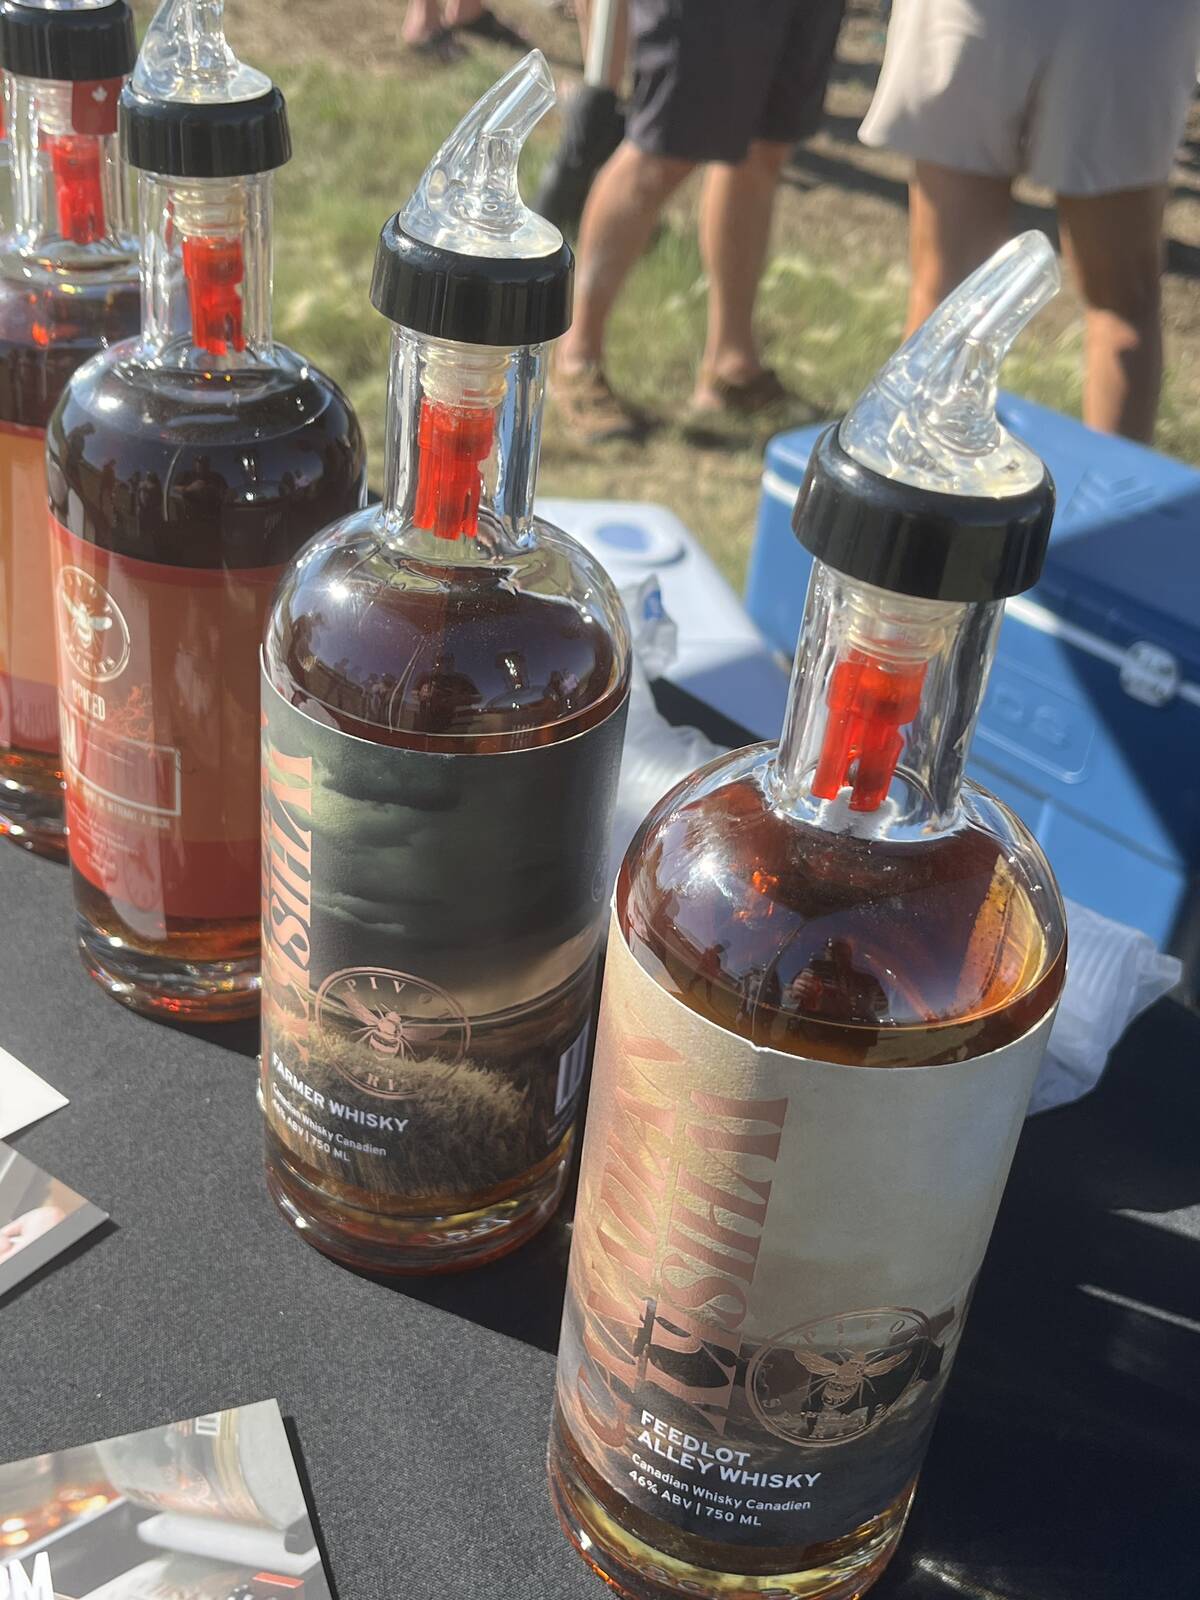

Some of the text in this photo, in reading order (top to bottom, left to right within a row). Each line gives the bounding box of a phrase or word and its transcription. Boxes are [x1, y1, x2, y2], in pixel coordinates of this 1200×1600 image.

[273, 1052, 325, 1109] FARMER
[329, 1099, 409, 1132] WHISKY
[301, 1113, 334, 1141] Whisky
[336, 1132, 387, 1156] Canadien
[311, 1135, 331, 1152] 750
[333, 1147, 351, 1162] ML
[643, 1090, 789, 1436] WHISKY
[637, 1430, 822, 1488] ALLEY WHISKY
[641, 1409, 750, 1467] FEEDLOT
[629, 1470, 659, 1494] 46%
[661, 1489, 693, 1510] ABV
[705, 1506, 735, 1522] 750
[739, 1515, 762, 1527] ML
[631, 1453, 811, 1511] Canadian Whisky Canadien
